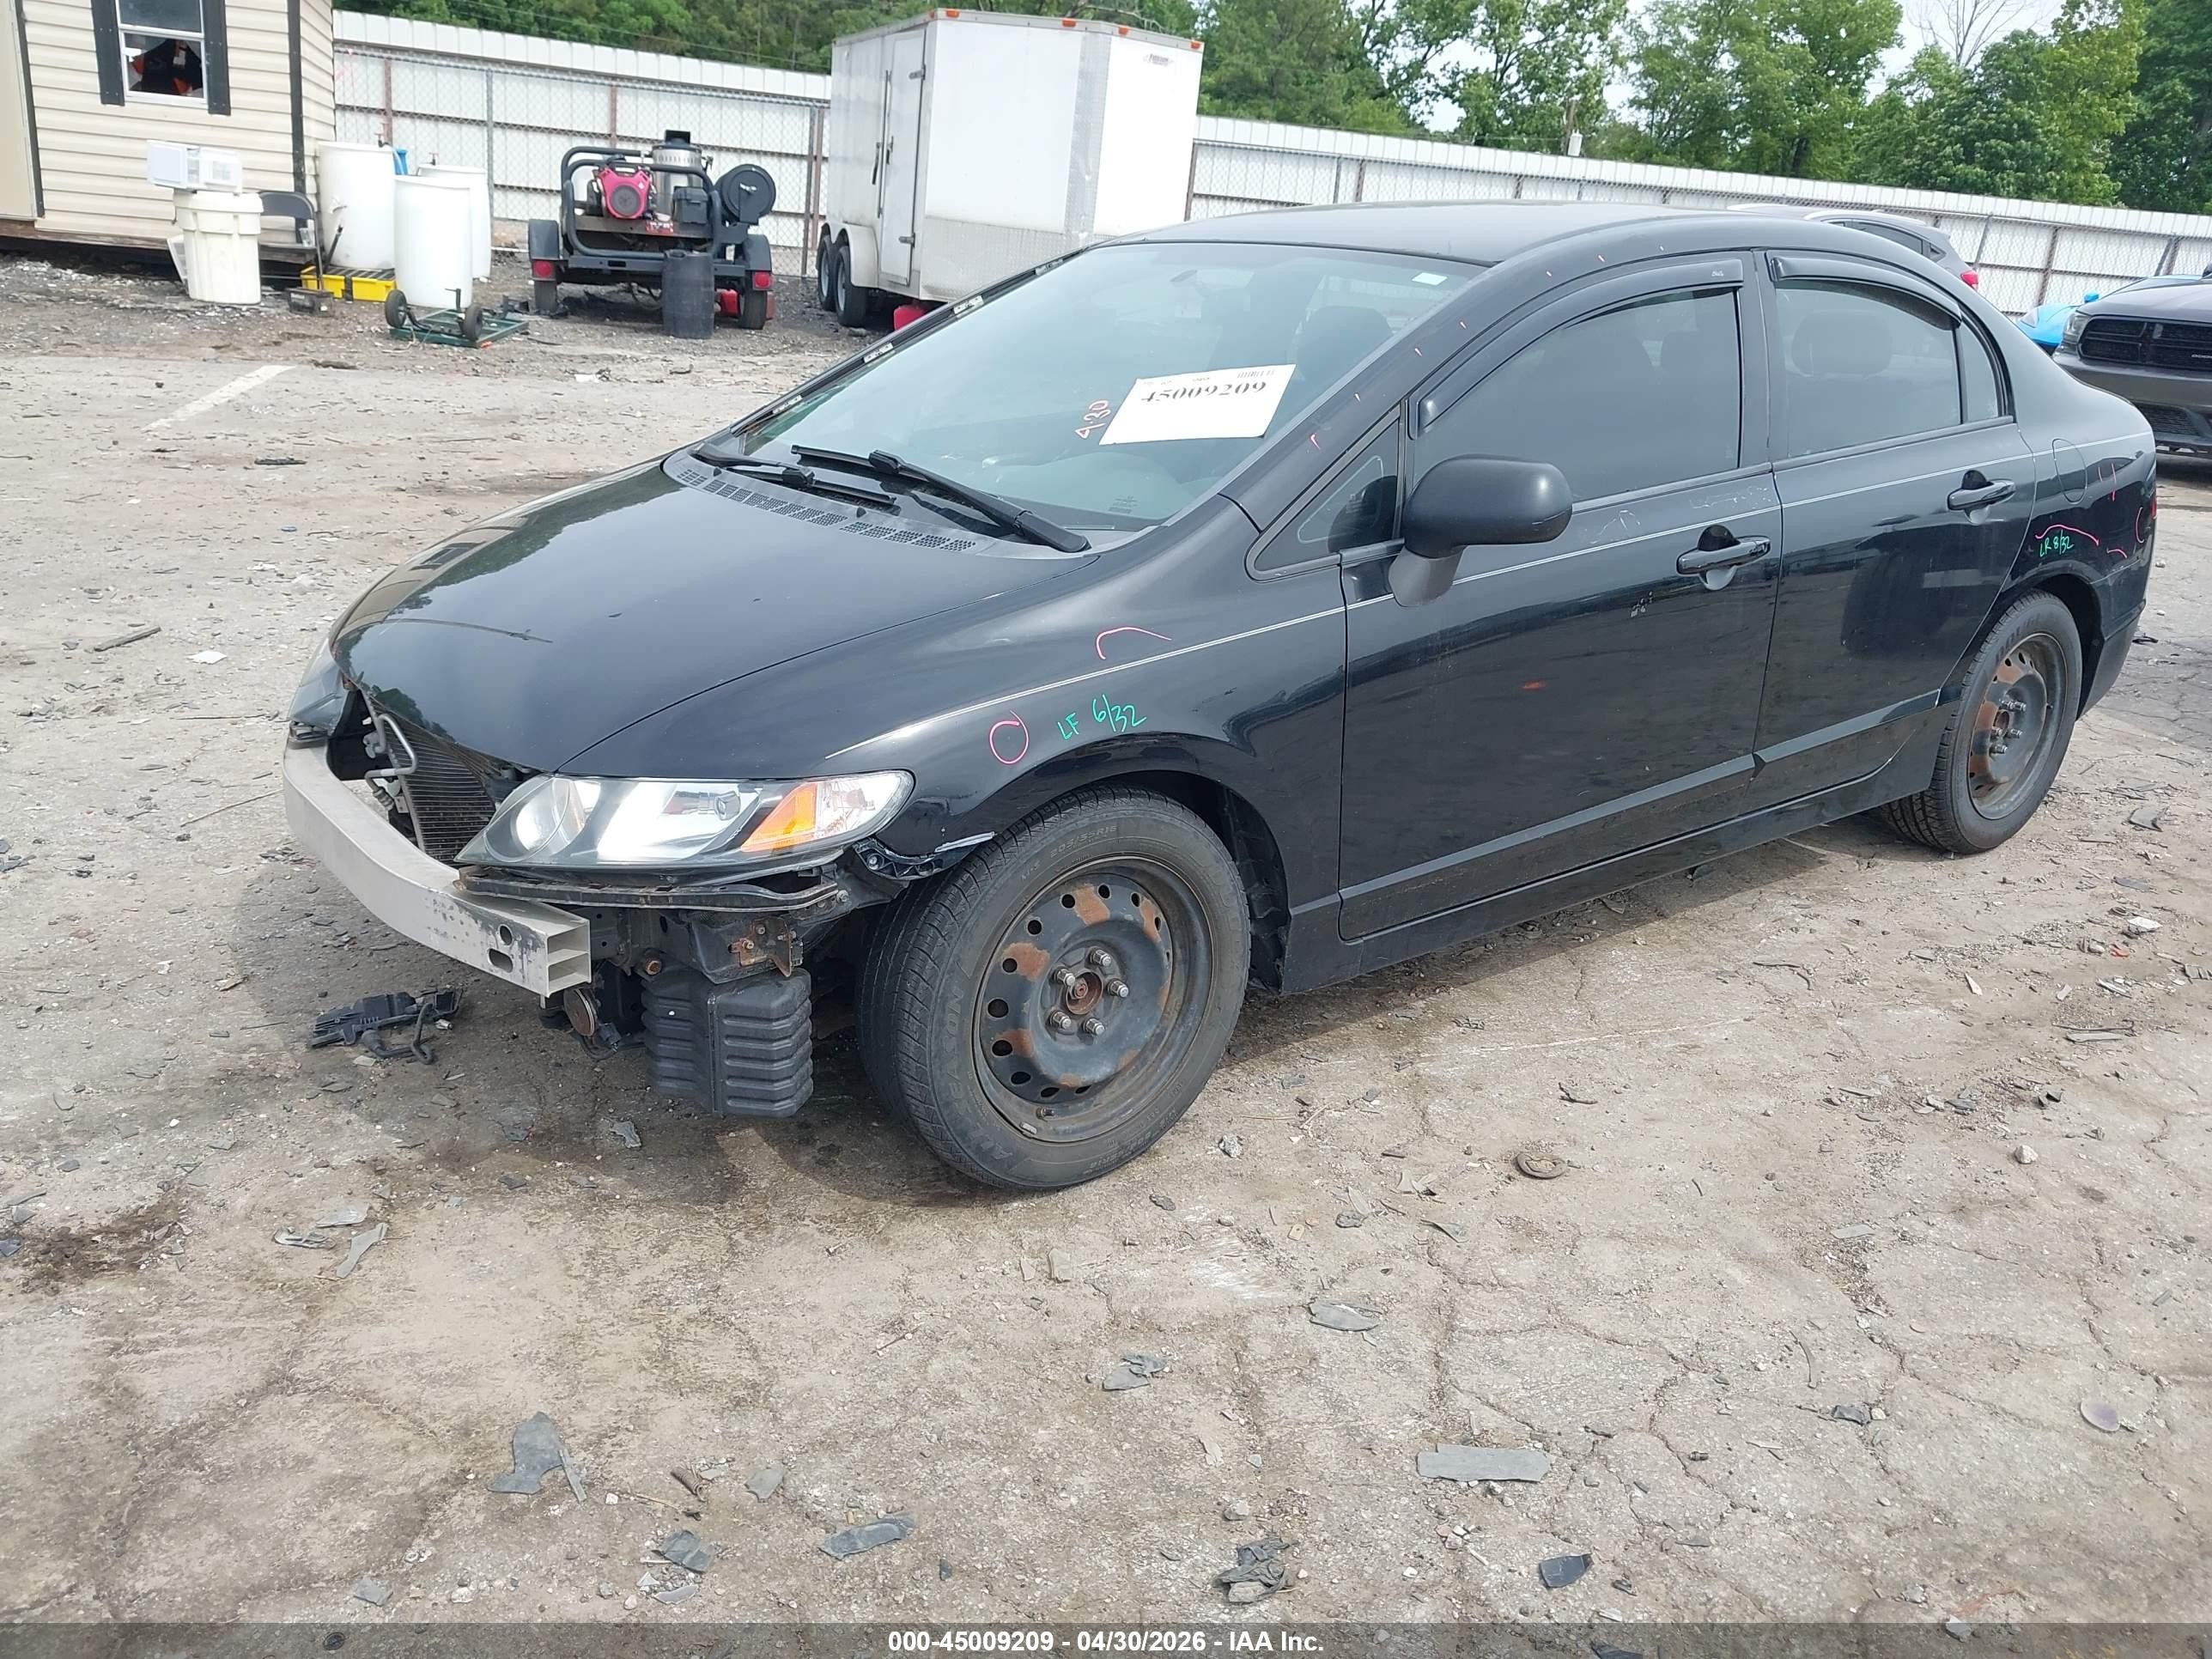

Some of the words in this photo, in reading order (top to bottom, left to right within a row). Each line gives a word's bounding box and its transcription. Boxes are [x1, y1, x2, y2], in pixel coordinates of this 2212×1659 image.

[1141, 381, 1267, 402] 45009209
[2039, 537, 2052, 557] LR
[2053, 528, 2075, 555] 8/32
[1057, 712, 1079, 739] LF
[1092, 694, 1147, 732] 6/32
